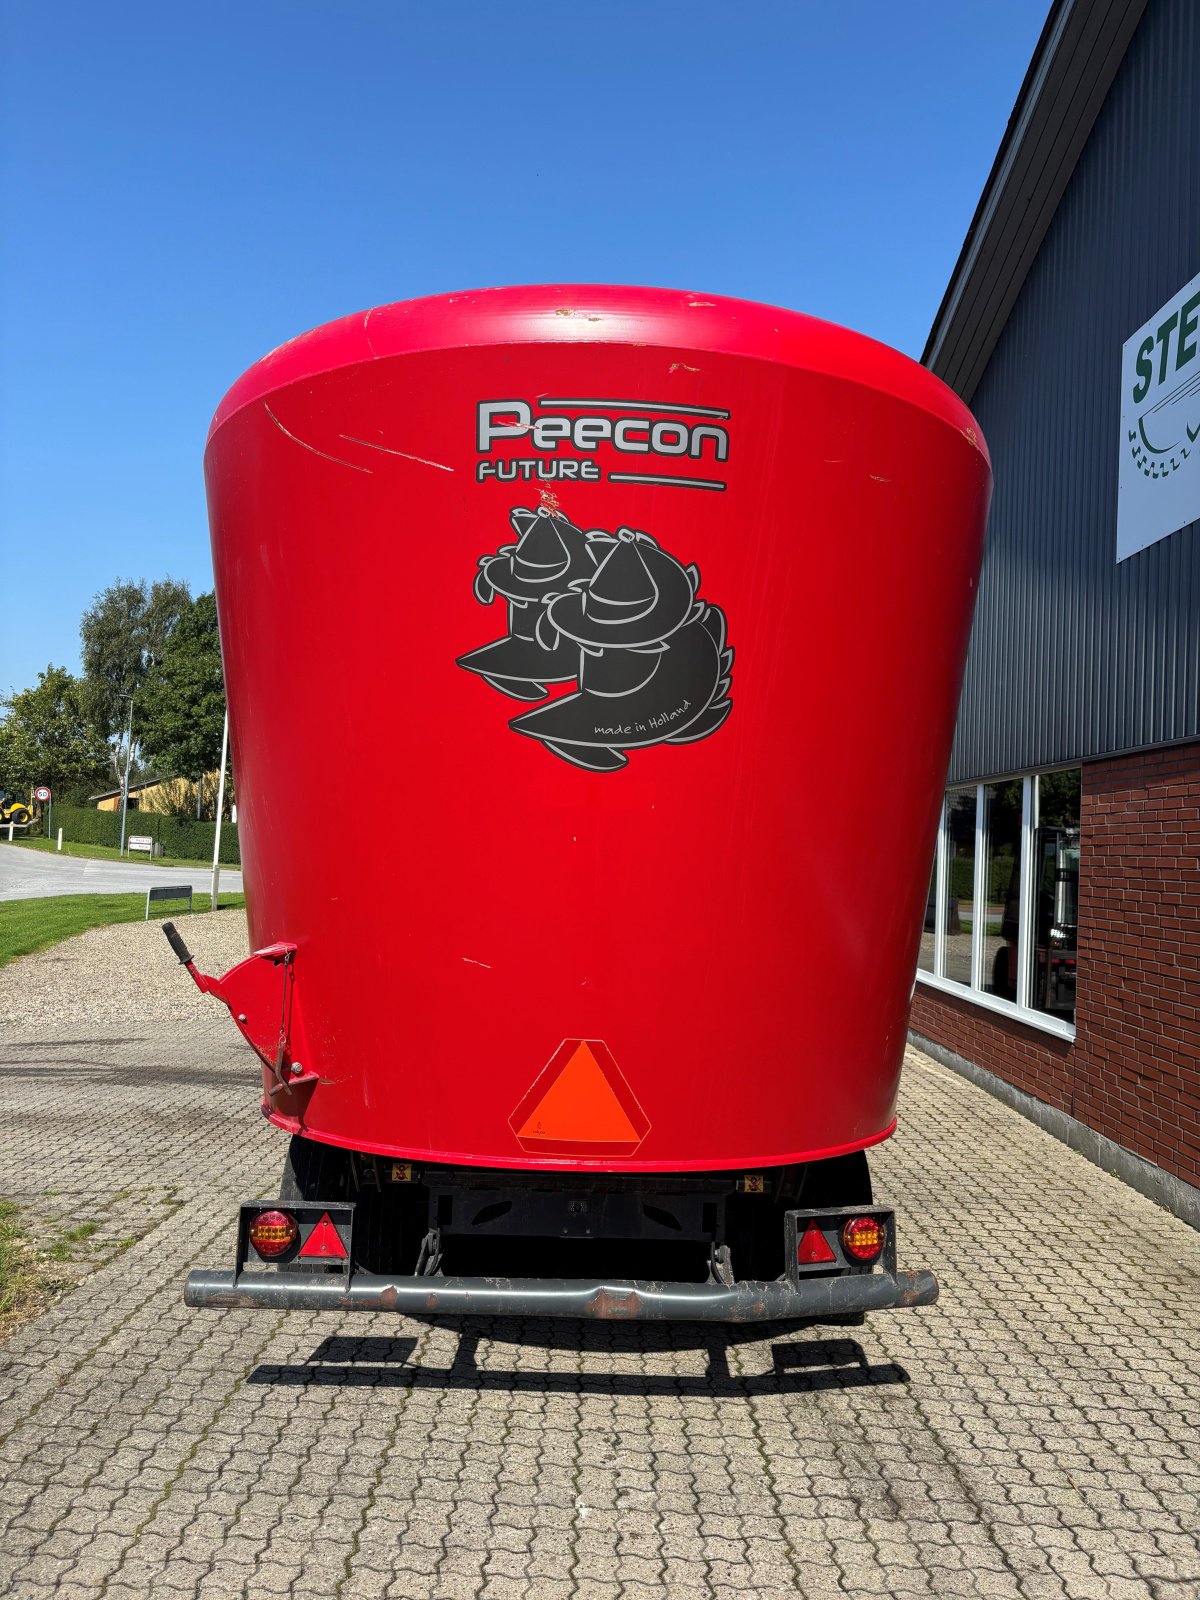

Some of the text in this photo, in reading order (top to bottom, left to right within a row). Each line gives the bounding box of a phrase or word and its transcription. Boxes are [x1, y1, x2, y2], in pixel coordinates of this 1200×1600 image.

[1133, 291, 1200, 404] STE
[477, 401, 729, 461] Peecon
[477, 459, 600, 482] FUTURE
[594, 699, 692, 734] made in Holland
